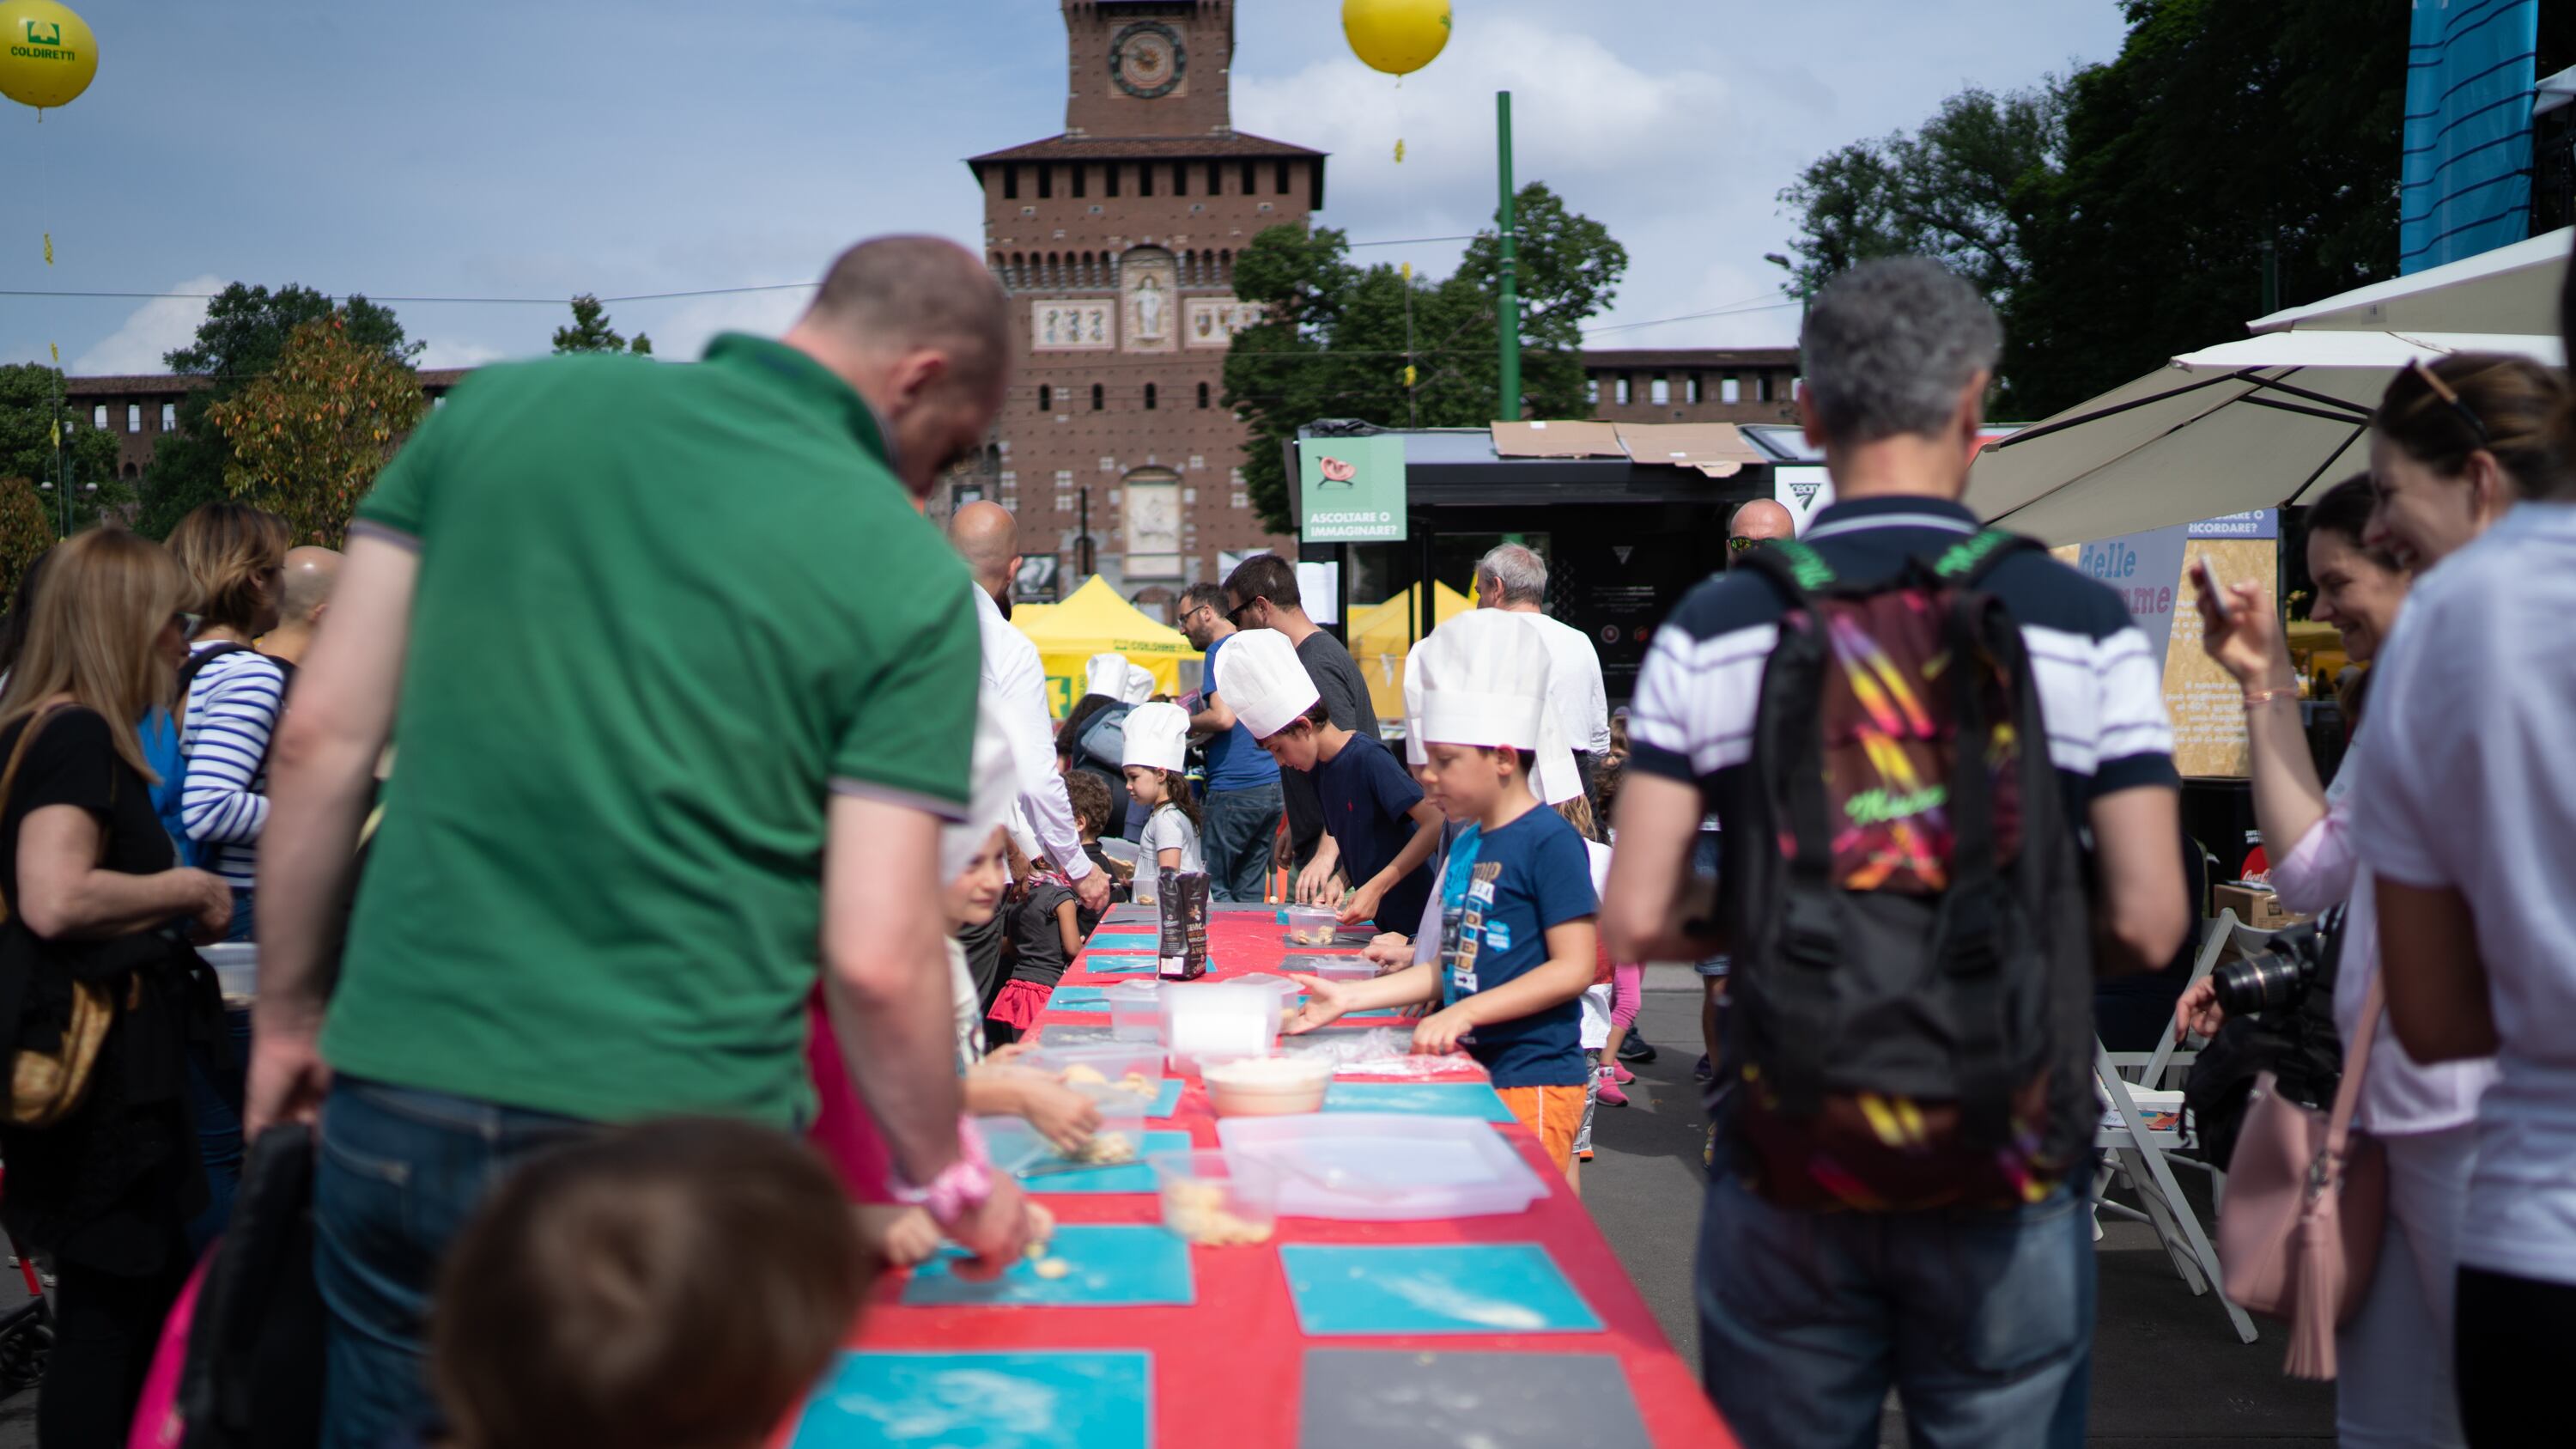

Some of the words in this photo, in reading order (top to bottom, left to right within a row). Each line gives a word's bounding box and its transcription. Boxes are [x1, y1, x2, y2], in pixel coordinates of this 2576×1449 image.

[10, 46, 76, 61] COLDIRETTI
[1310, 513, 1376, 523] ASCOLTARE
[1379, 512, 1390, 522] O
[1310, 525, 1397, 537] IMMAGINARE?
[2188, 522, 2257, 533] RICORDARE?
[2081, 542, 2136, 578] delle
